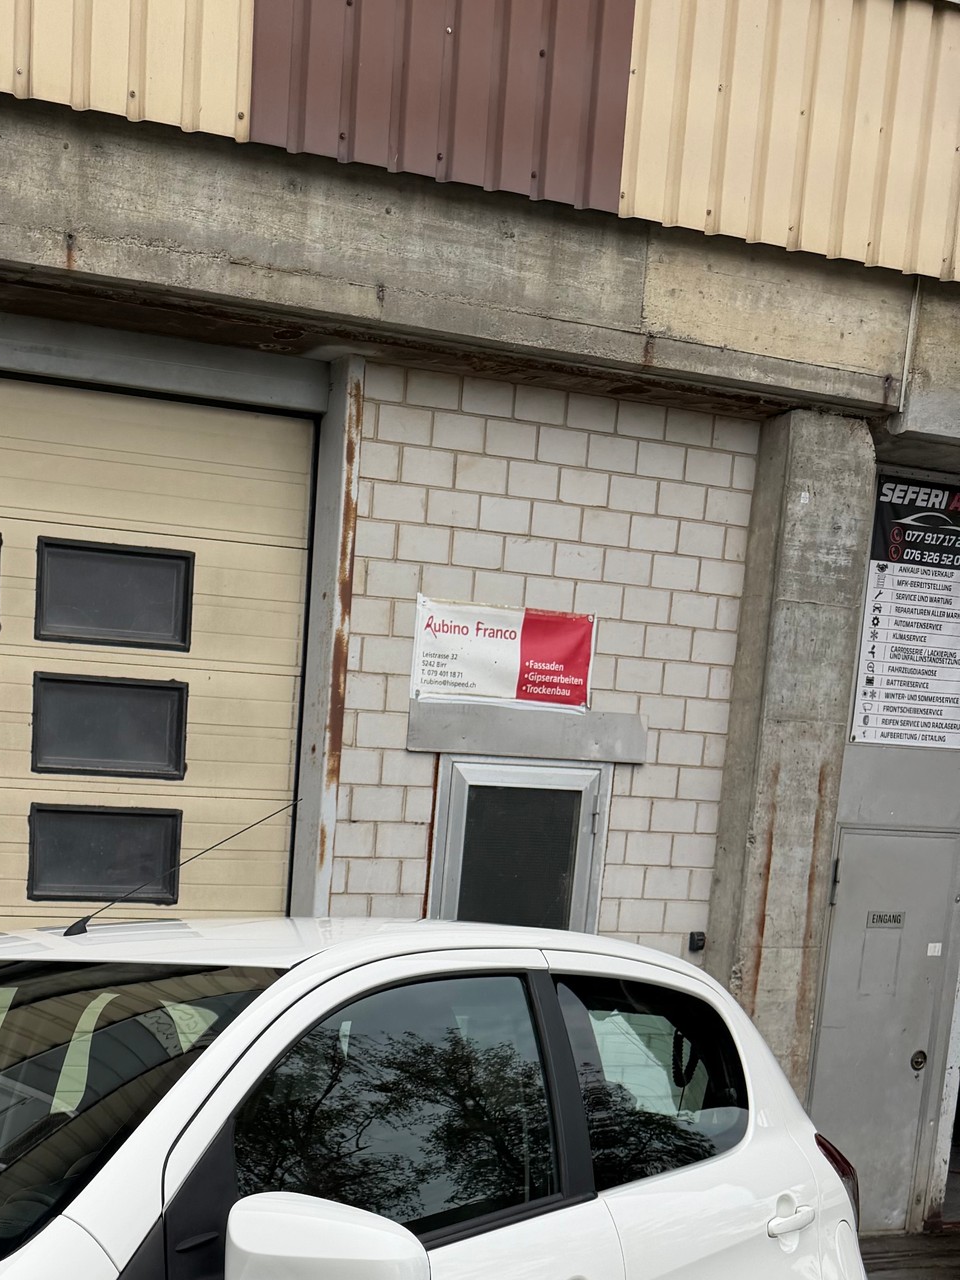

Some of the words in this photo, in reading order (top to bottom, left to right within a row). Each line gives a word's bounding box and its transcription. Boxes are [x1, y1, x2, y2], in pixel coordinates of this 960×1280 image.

[880, 483, 949, 509] SEFERI
[905, 530, 924, 542] 077
[903, 548, 921, 560] 076
[921, 551, 940, 563] 326
[940, 553, 953, 565] 52
[898, 566, 920, 575] ANKAUF
[920, 568, 931, 576] UND
[931, 569, 955, 578] VERKAUF
[895, 592, 917, 602] SERVICE
[917, 594, 929, 603] UND
[929, 596, 952, 606] WARTUNG
[895, 606, 930, 616] REPARATUREN
[930, 609, 946, 618] ALLER
[424, 615, 469, 639] Rubino
[475, 621, 518, 641] Franco
[894, 619, 943, 631] AUTOMATENSERVICE
[892, 632, 927, 643] KLIMASERVICE
[422, 651, 450, 660] Leistrasse
[890, 645, 924, 656] CARROSSERIE
[927, 649, 957, 659] LACKIERUNG
[529, 660, 564, 671] Fassaden
[887, 665, 937, 677] FAHRZEUGDIAGNOSE
[427, 669, 438, 677] 079
[528, 671, 584, 686] Gipserarbeiten
[886, 678, 929, 690] BATTERIESERVICE
[526, 684, 571, 697] Trockenbau
[907, 693, 918, 701] UND
[882, 705, 944, 717] FRONTSCHEIBENSERVICE
[881, 718, 899, 726] REIFEN
[899, 719, 920, 728] SERVICE
[920, 721, 931, 729] UND
[880, 731, 918, 741] AUFBEREITUNG
[921, 733, 946, 743] DETAILING
[871, 914, 902, 924] EINGANG
